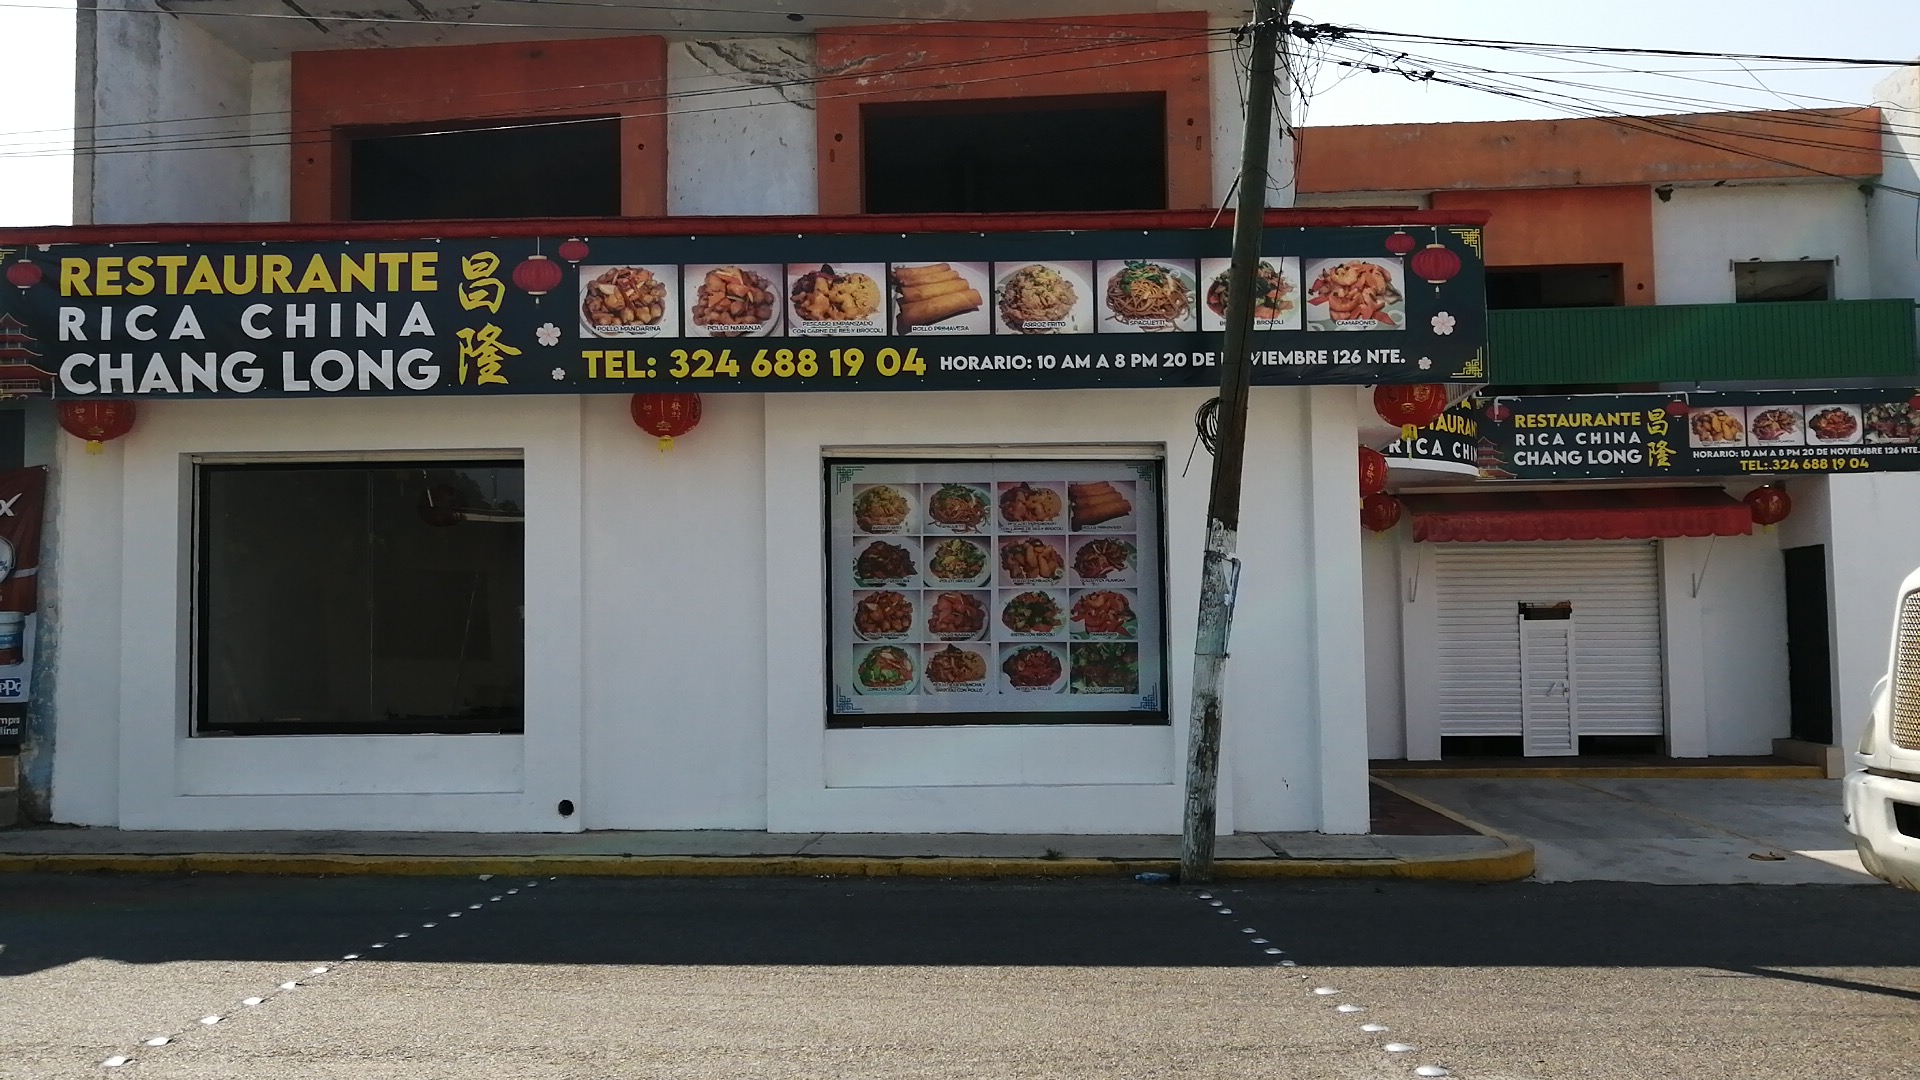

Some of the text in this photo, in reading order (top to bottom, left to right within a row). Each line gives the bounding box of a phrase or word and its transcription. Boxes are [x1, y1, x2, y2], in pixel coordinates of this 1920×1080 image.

[59, 251, 439, 297] RESTAURANTE
[58, 301, 437, 342] RICA CHINA
[456, 250, 522, 387] 昌隆
[581, 347, 927, 379] TEL: 324 688 19 04
[940, 349, 1406, 371] HORARIO: 10 AM A 8 PM 20 DE VIEMBRE 126 NTE.
[58, 348, 442, 394] CHANG LONG
[1514, 411, 1642, 428] RESTAURANTE
[1388, 437, 1444, 456] RICA
[1515, 431, 1642, 446] RICA CHINA
[1513, 449, 1643, 466] CHANG LONG
[1692, 450, 1739, 459] HORARIO:
[1740, 449, 1751, 458] 10
[1752, 449, 1768, 457] AM
[1769, 449, 1777, 457] A
[1778, 449, 1785, 457] 8
[1786, 448, 1800, 457] PM
[1802, 448, 1814, 456] 20
[1816, 448, 1828, 456] DE
[1831, 447, 1884, 456] NOVIEMBRE
[1884, 446, 1900, 455] 126
[1772, 459, 1799, 470] 324
[1802, 458, 1829, 470] 688
[1832, 457, 1846, 470] 19
[1849, 457, 1870, 469] 04
